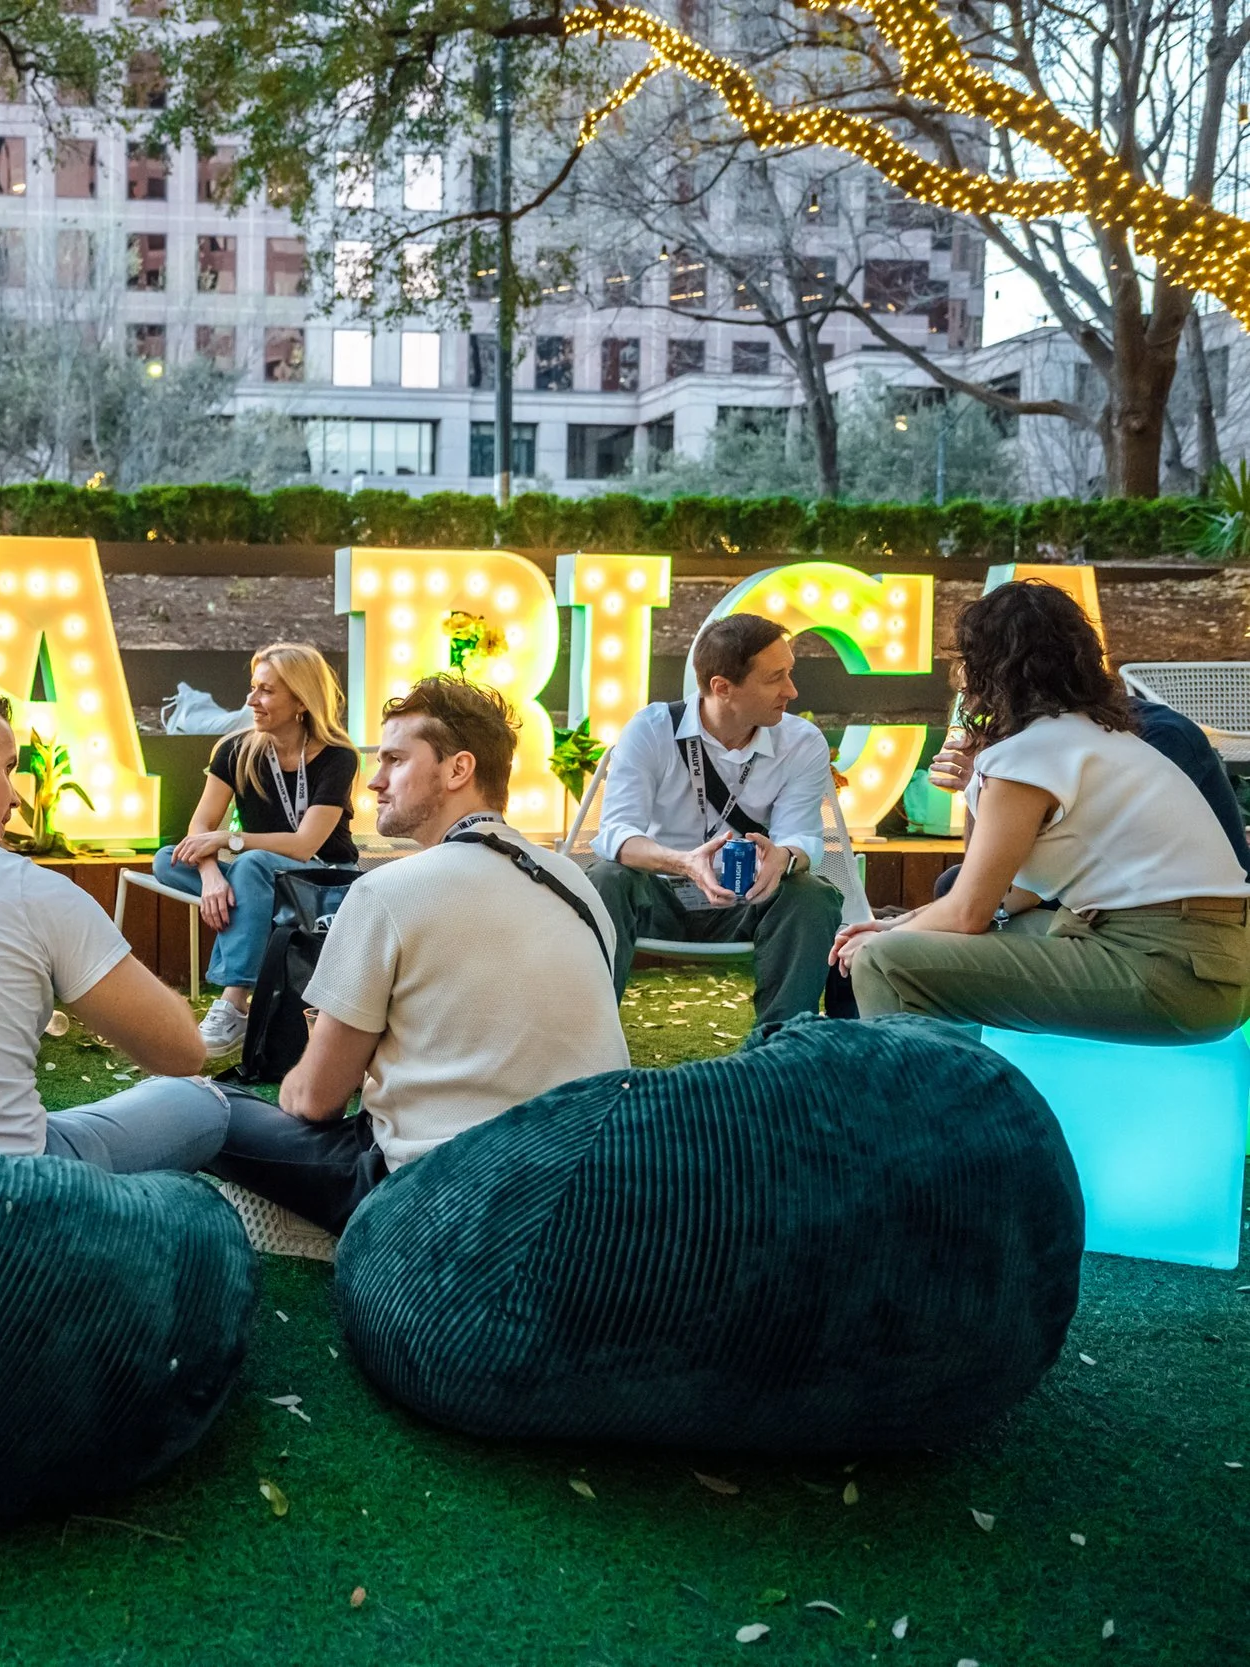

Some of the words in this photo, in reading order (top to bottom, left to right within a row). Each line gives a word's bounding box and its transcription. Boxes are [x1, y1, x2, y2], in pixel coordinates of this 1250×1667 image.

[334, 546, 1109, 840] RIC
[690, 740, 701, 776] PLATINUM
[739, 766, 751, 785] 2025
